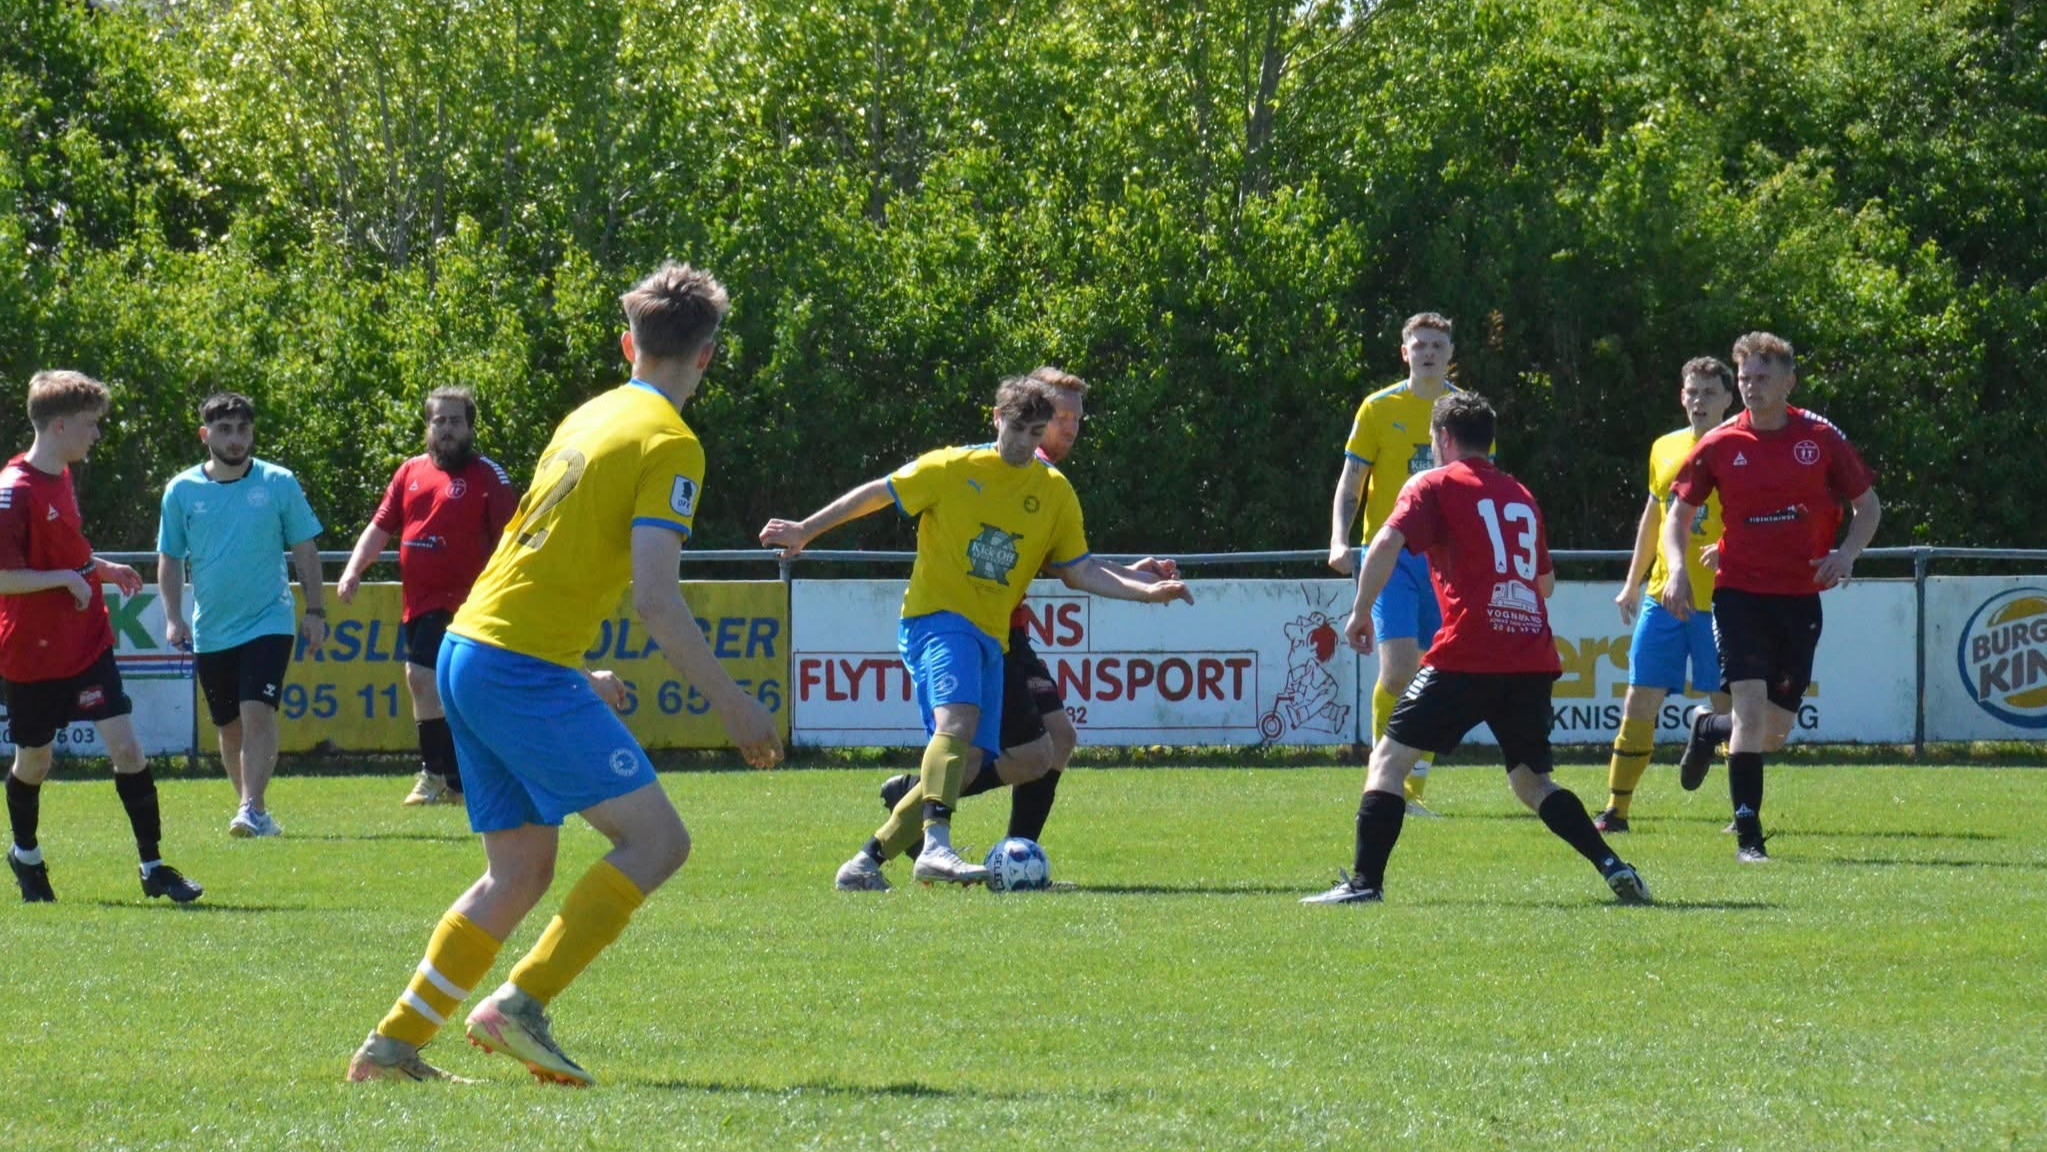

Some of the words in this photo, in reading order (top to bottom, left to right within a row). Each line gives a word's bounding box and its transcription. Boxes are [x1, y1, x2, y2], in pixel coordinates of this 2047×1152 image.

[1477, 498, 1537, 580] 13
[1023, 603, 1084, 647] NS
[1972, 618, 2047, 664] BURG
[800, 658, 913, 702] FLYTT
[1057, 657, 1252, 702] NSPORT
[1980, 649, 2047, 700] KIN
[283, 683, 339, 719] 95
[357, 683, 398, 719] 11
[657, 680, 712, 715] 65
[1551, 704, 1621, 731] KNIS
[72, 728, 95, 744] 03
